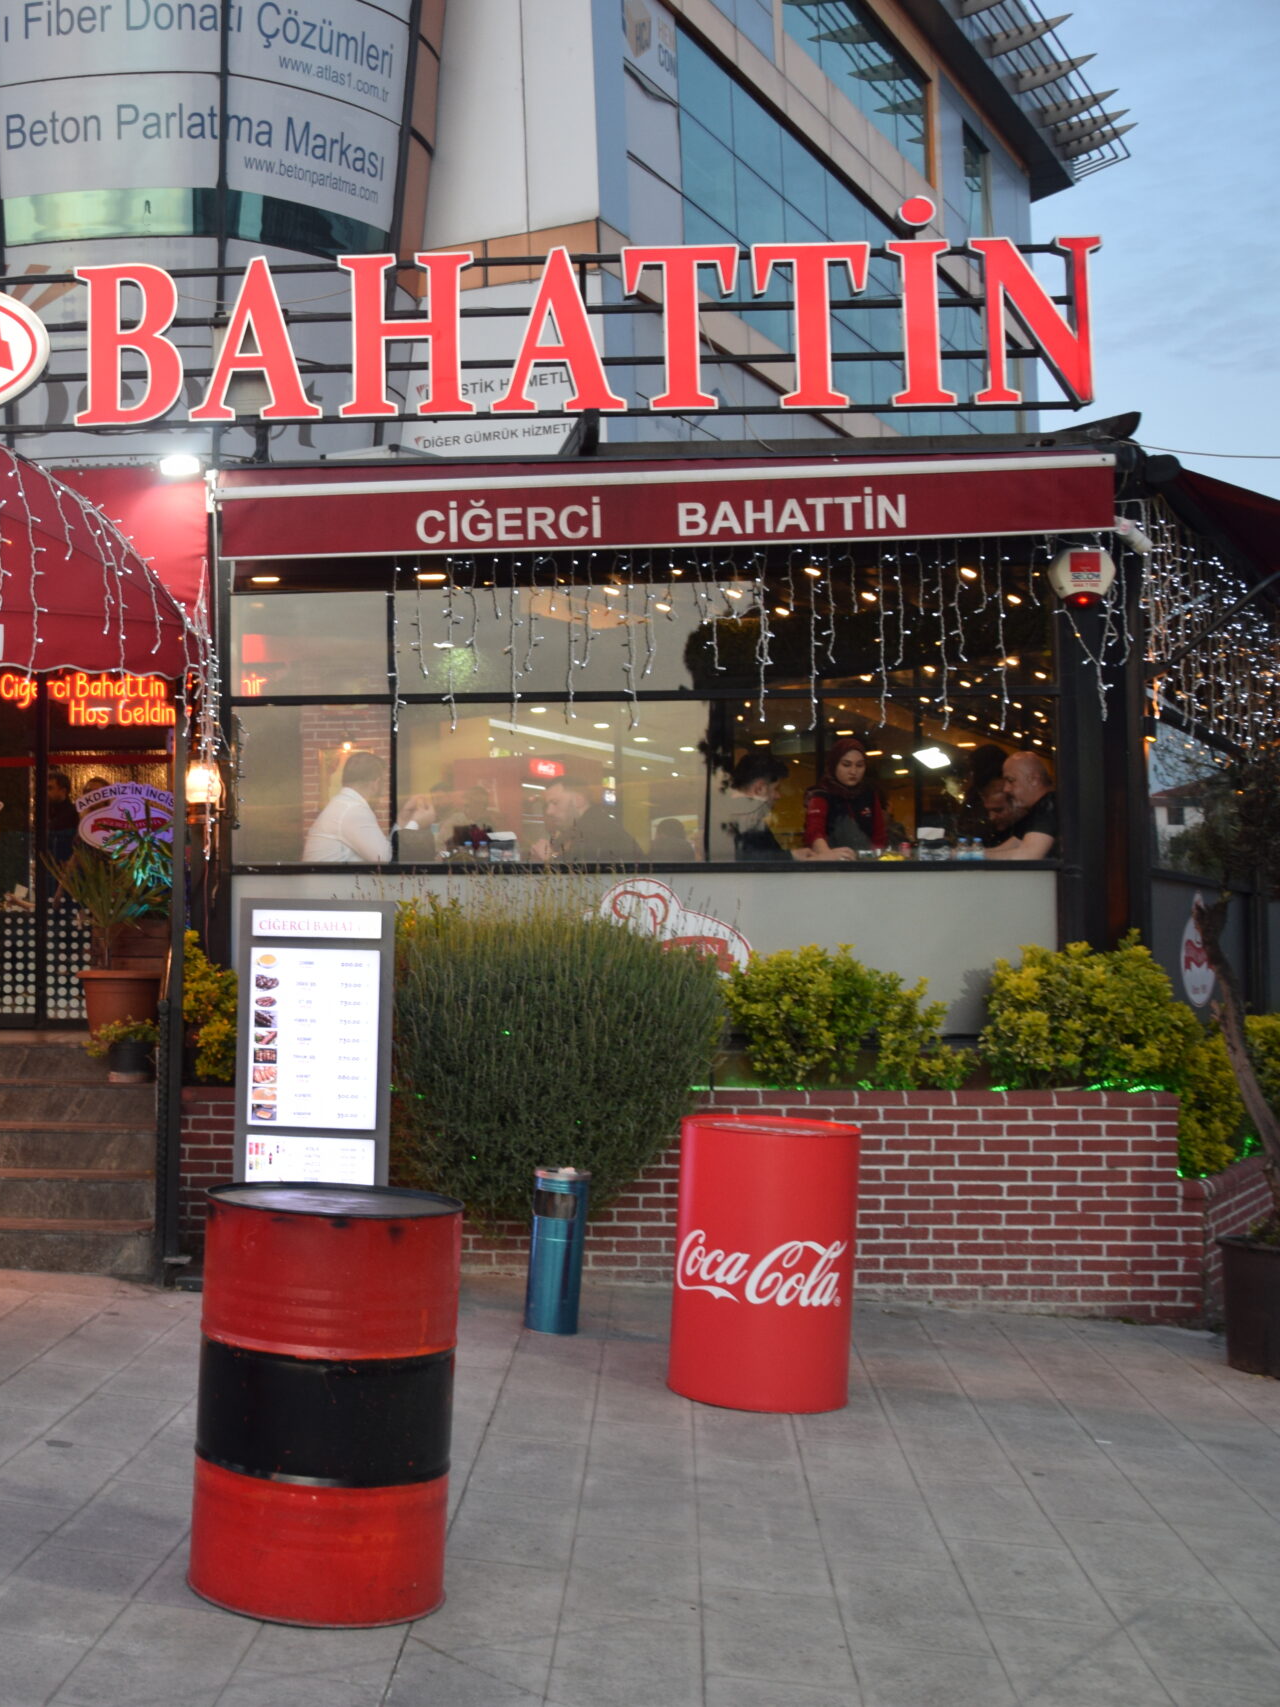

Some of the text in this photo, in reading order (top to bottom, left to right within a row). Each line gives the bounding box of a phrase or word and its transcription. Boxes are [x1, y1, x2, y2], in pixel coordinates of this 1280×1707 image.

[23, 0, 113, 39] Fiber
[256, 1, 394, 79] Çözümleri
[278, 54, 390, 103] www.atlas1.com.tr
[5, 110, 102, 151] Beton
[116, 102, 273, 148] Parlatma
[284, 116, 385, 182] Markası
[243, 155, 379, 204] www.betonparlatma.com
[72, 195, 1104, 428] BAHATTİN
[423, 435, 461, 449] DİĞER
[464, 428, 519, 444] GÜMRÜK
[415, 486, 908, 545] CİĞERCİ BAHATTİN
[75, 672, 166, 699] Bahattin
[118, 699, 177, 725] Geldin
[146, 785, 174, 808] İNCİS
[258, 917, 310, 931] CİĞERCİ
